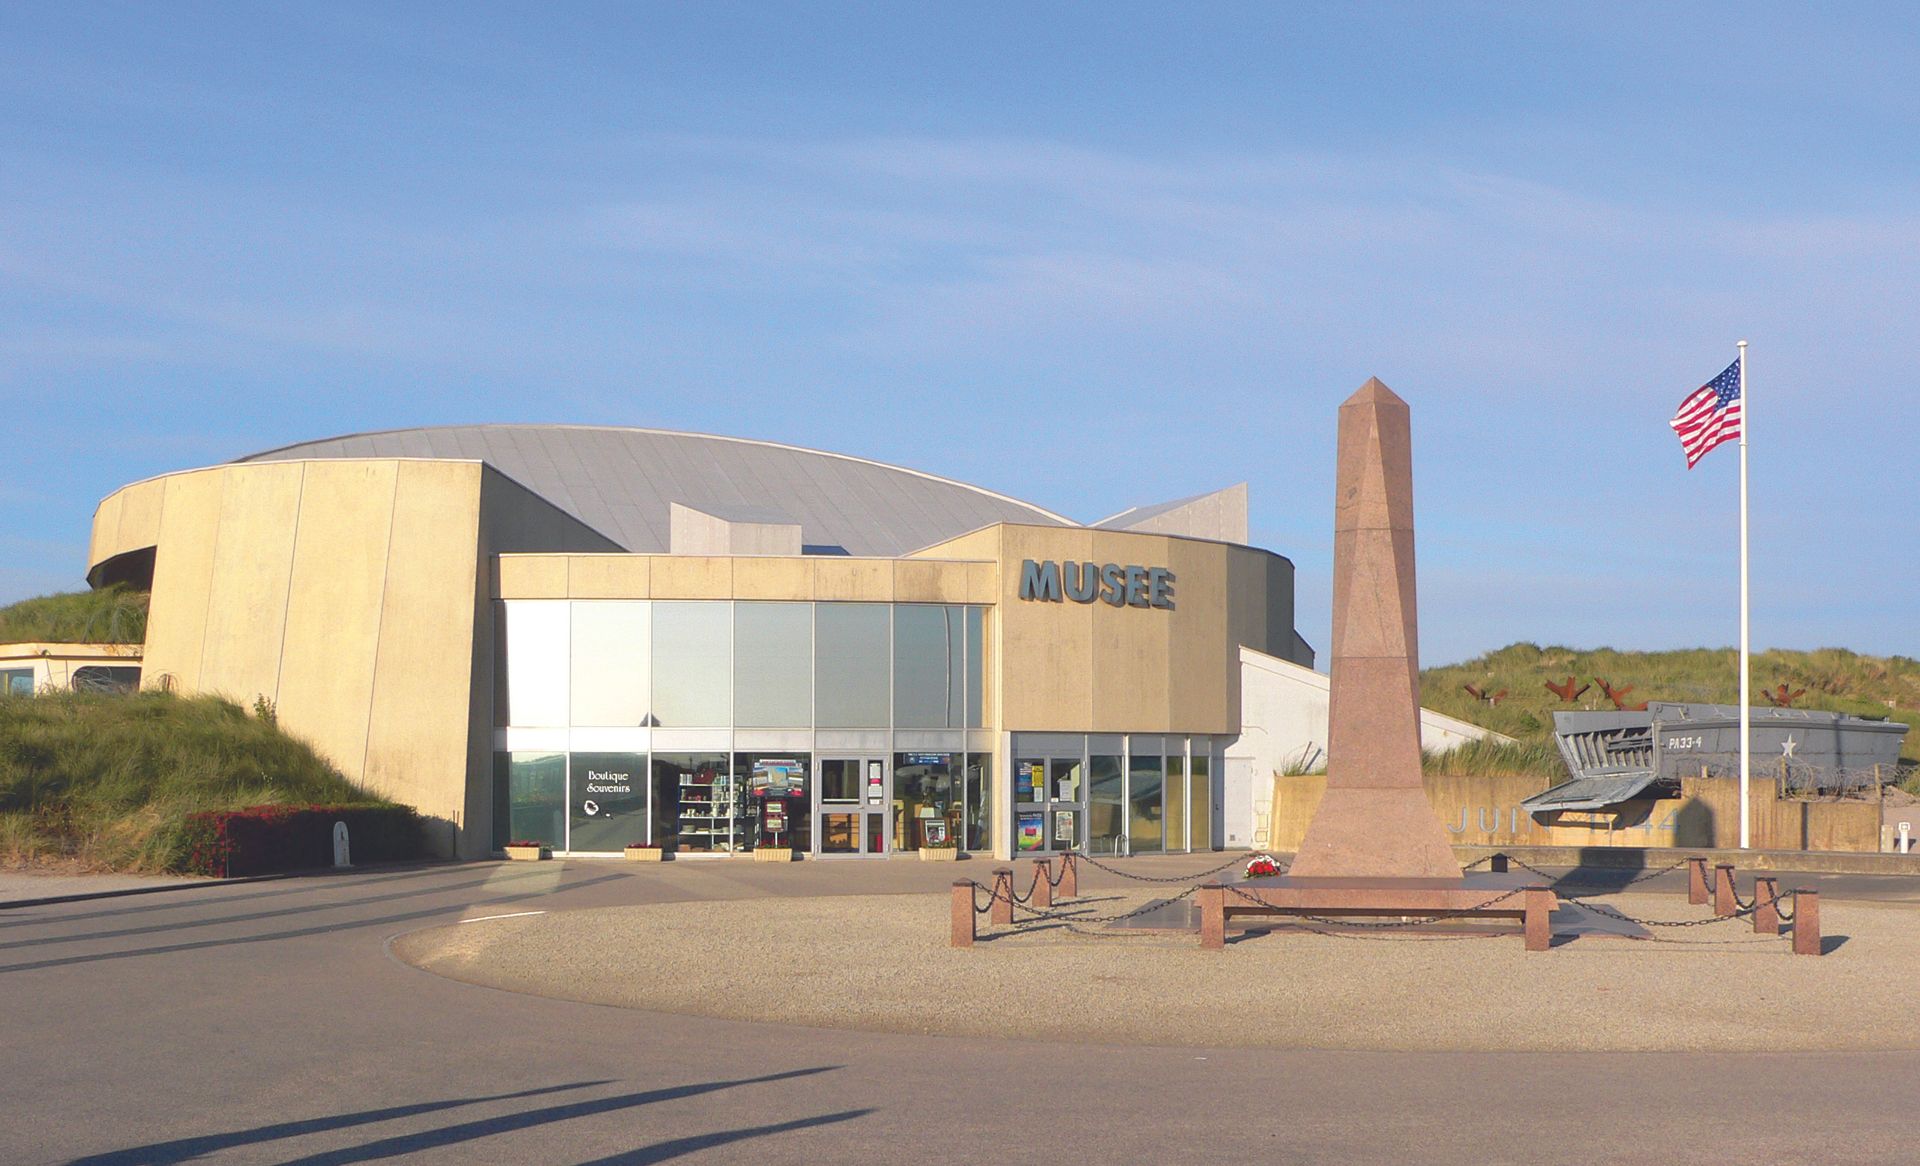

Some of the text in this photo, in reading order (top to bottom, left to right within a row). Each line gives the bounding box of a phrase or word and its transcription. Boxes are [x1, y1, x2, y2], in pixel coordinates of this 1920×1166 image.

[1018, 559, 1177, 611] MUSEE
[1668, 736, 1702, 750] PA33-4
[588, 770, 629, 784] Boutique
[586, 782, 631, 793] Souvenirs
